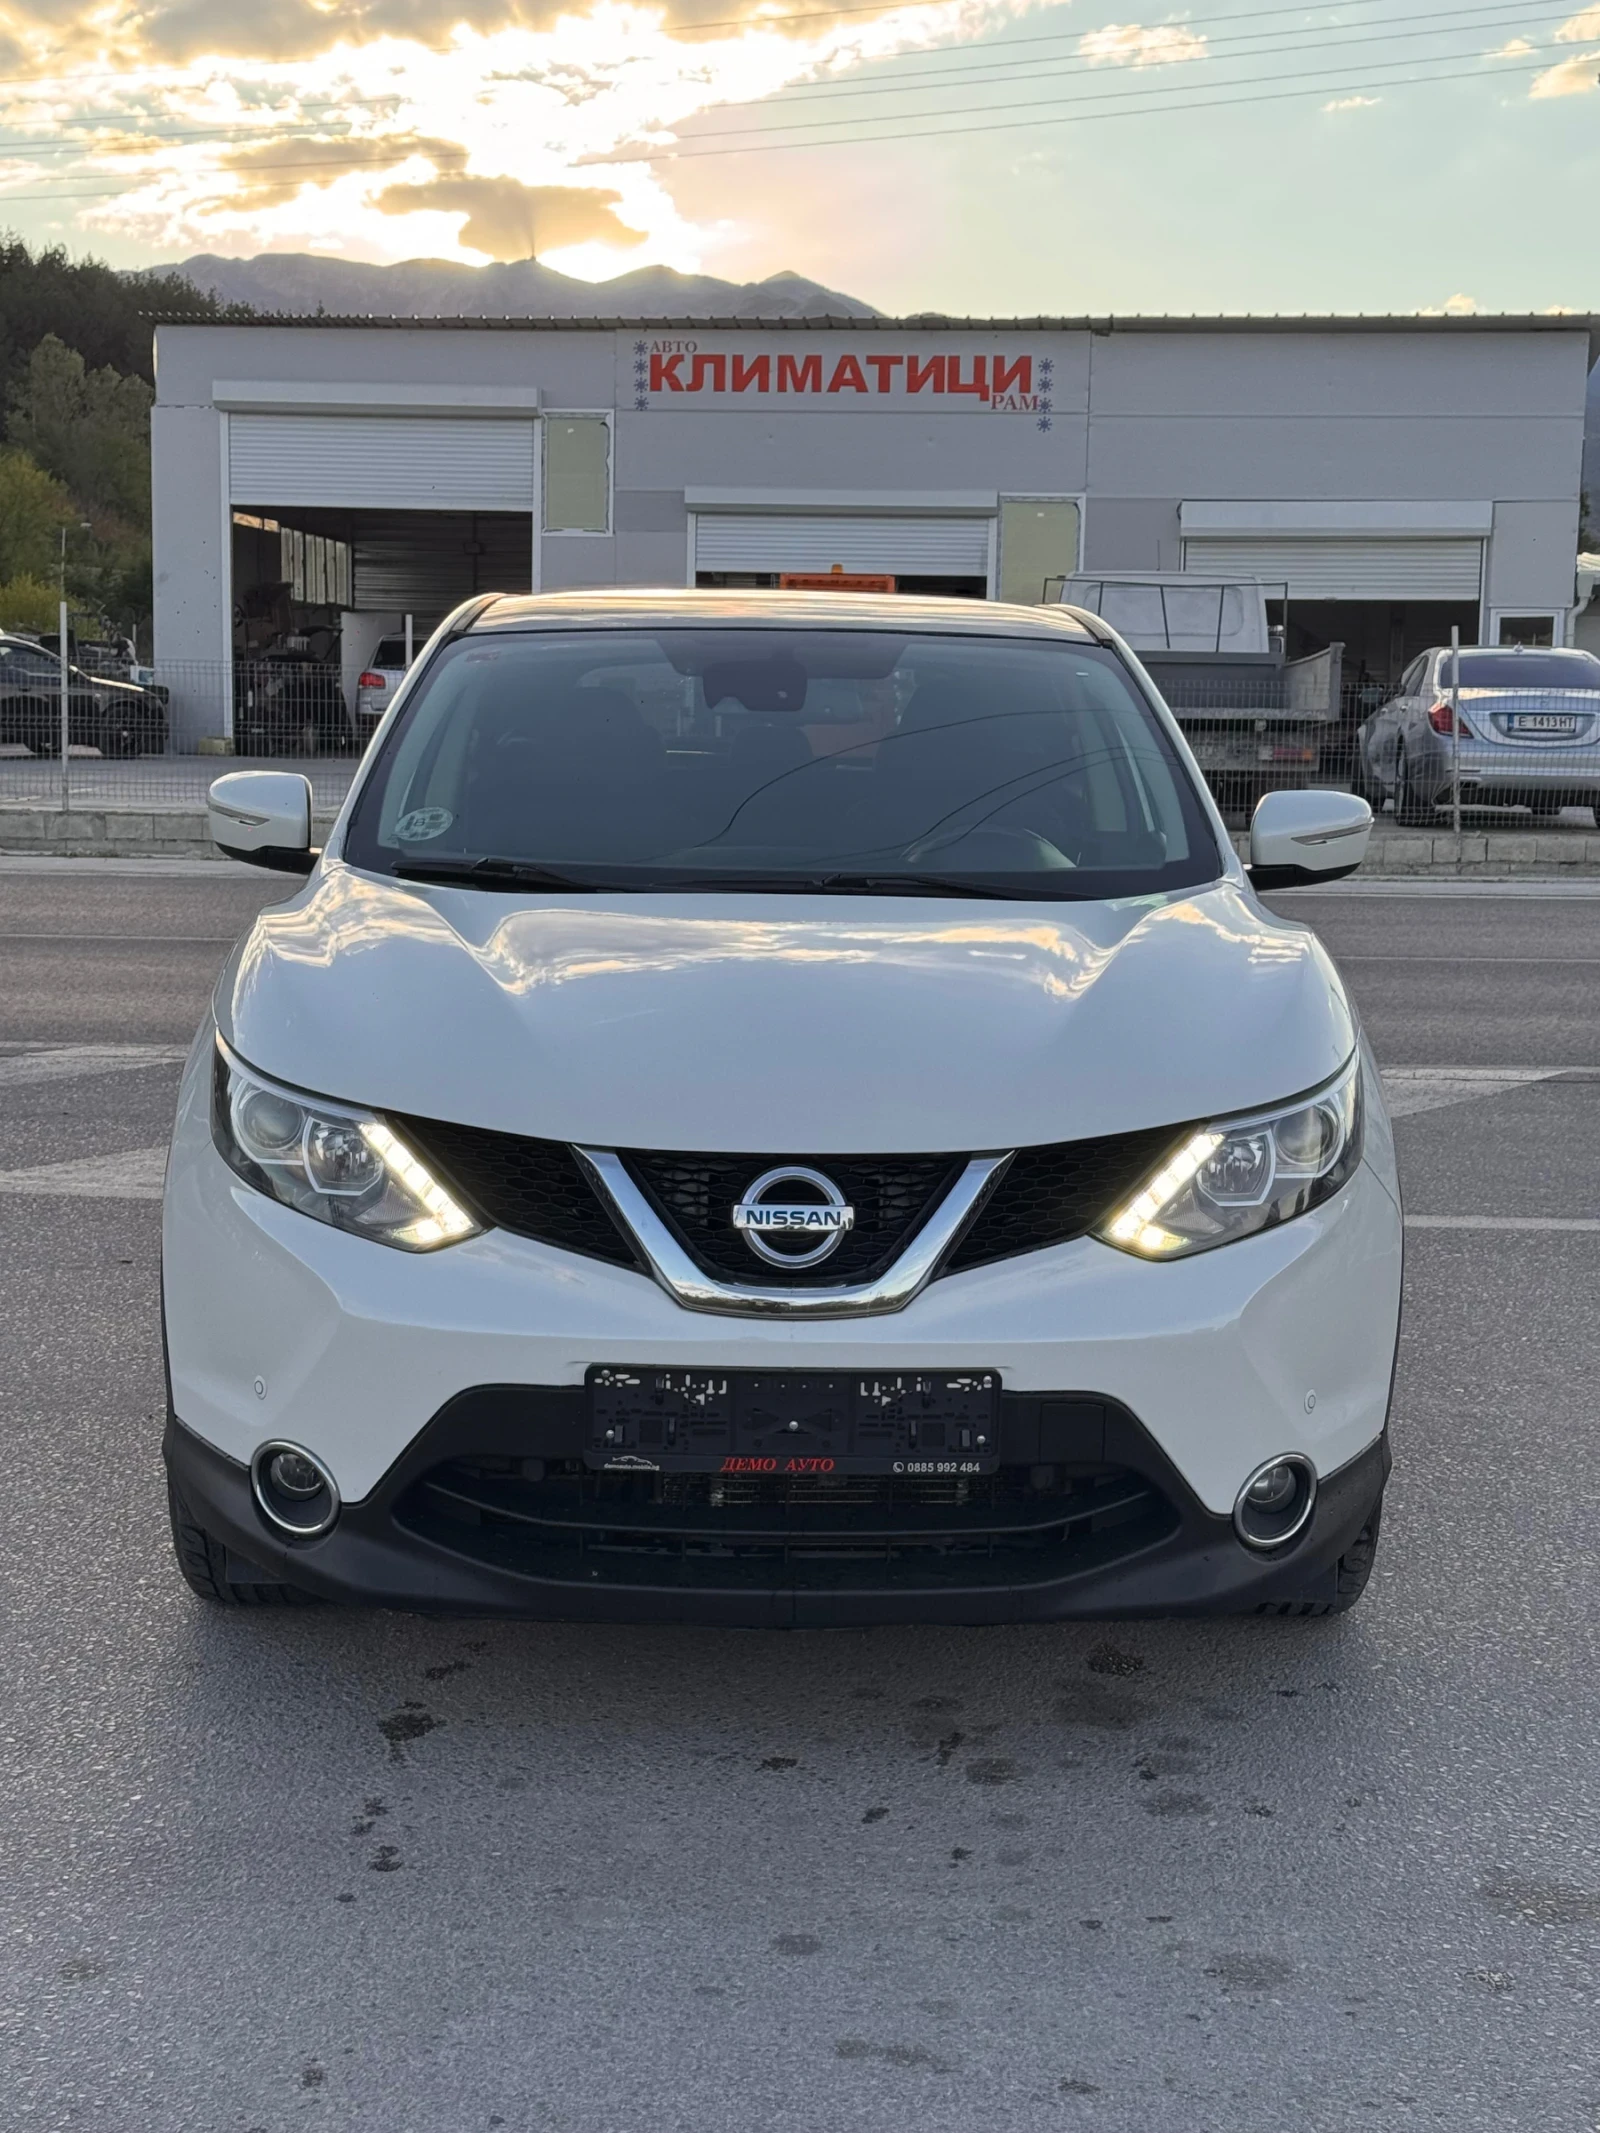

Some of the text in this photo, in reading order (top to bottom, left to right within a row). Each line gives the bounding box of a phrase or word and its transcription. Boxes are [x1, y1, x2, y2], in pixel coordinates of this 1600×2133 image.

[650, 340, 698, 353] АВТО
[649, 354, 1032, 402] КЛИМАТИЦИ
[991, 394, 1039, 410] РАМ
[746, 1210, 841, 1226] NISSAN
[720, 1456, 835, 1472] ДЕМО АУТО
[907, 1462, 981, 1473] 0885 992 484
